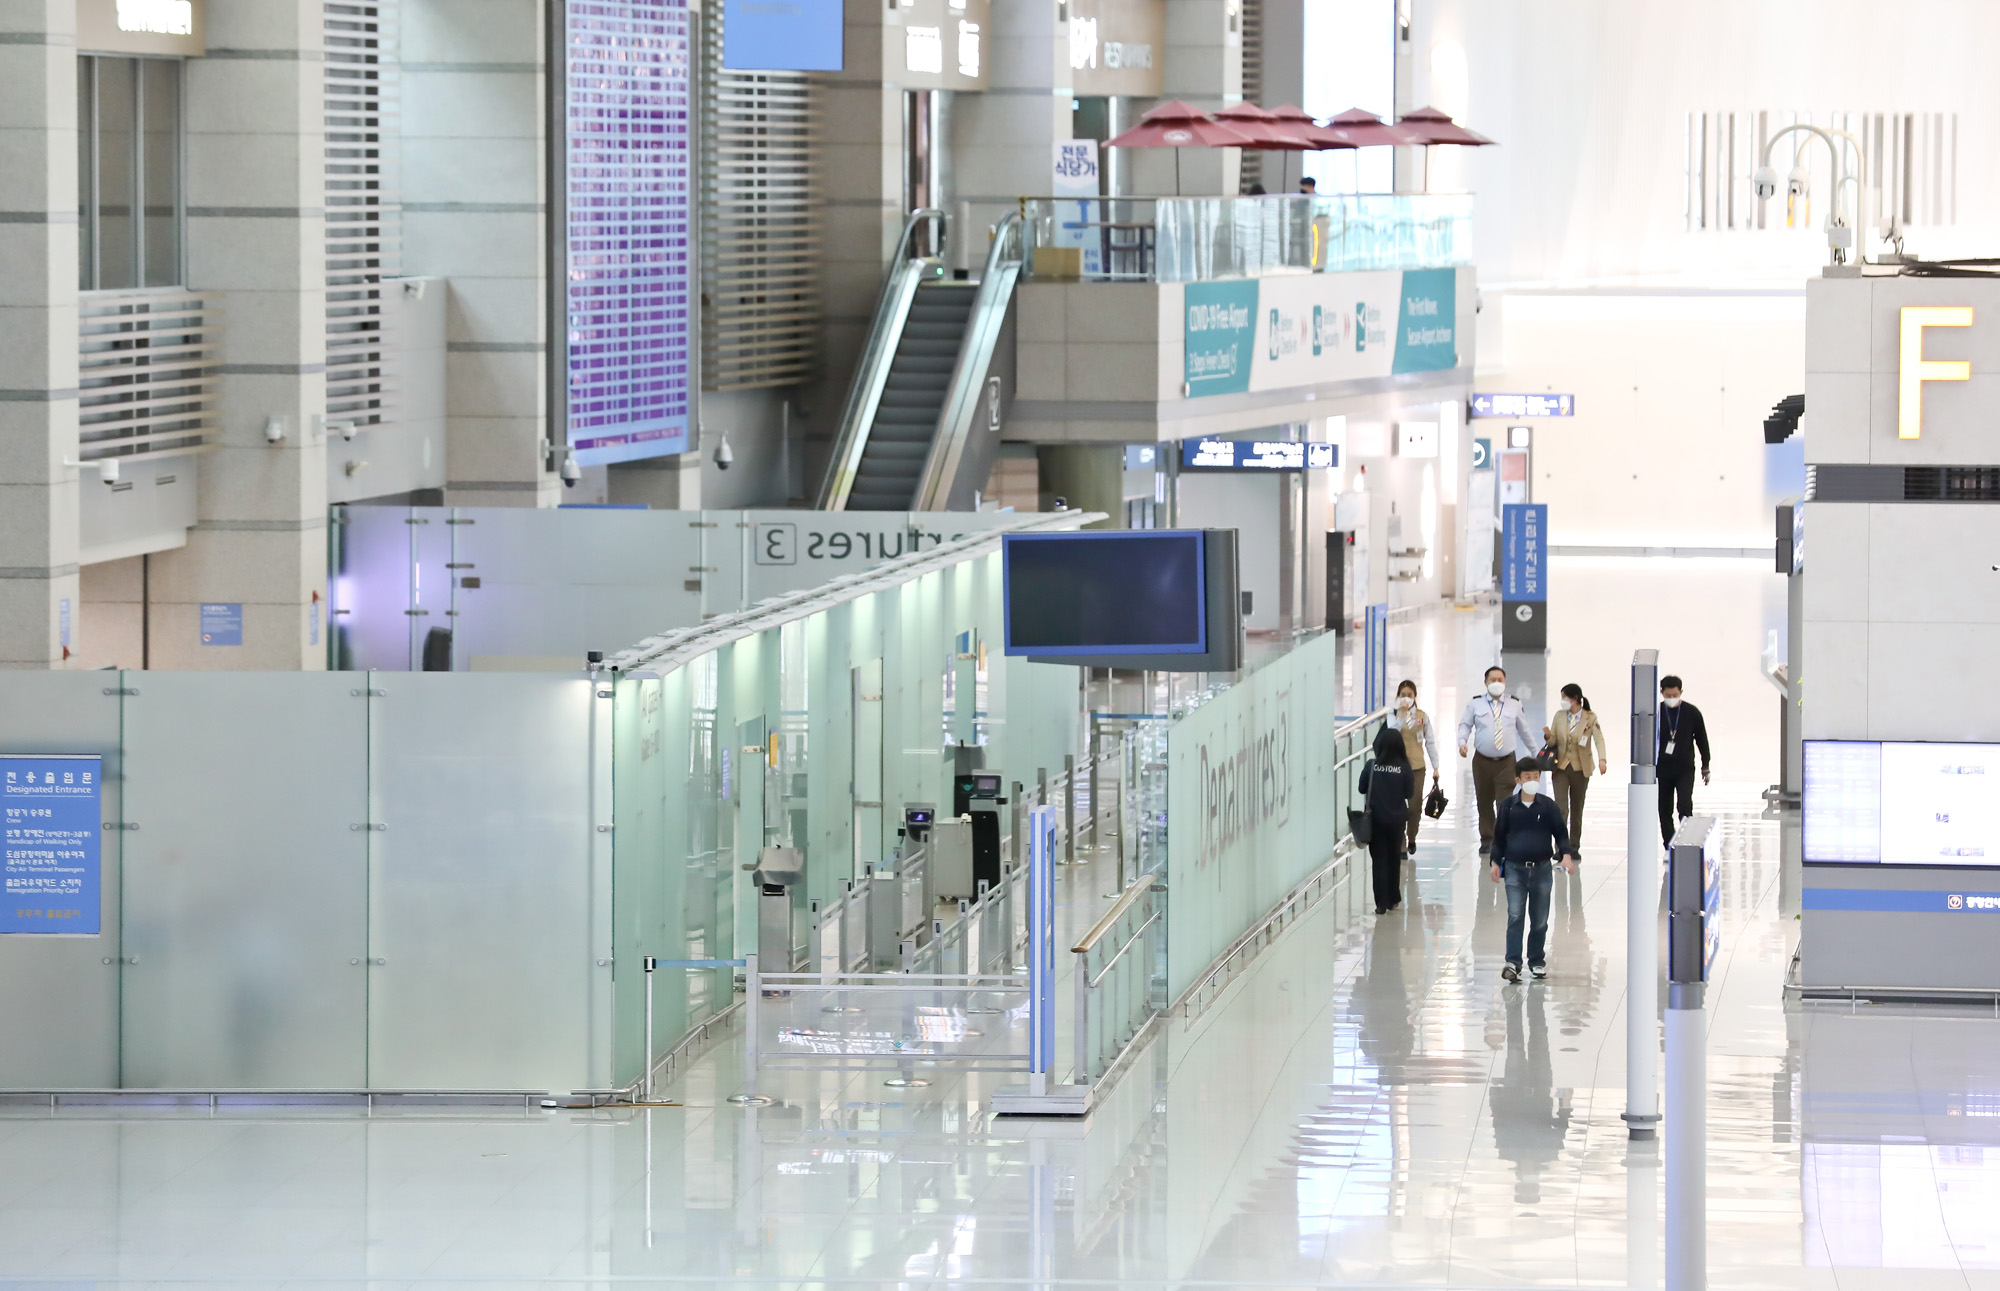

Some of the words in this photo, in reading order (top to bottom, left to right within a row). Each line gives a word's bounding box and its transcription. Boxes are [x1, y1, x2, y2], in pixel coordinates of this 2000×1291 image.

[1061, 145, 1088, 162] 전문
[1056, 161, 1097, 177] 식당가
[1189, 304, 1216, 331] COVID-19
[1229, 302, 1249, 334] Airport
[1899, 306, 1974, 440] F
[1373, 764, 1401, 774] CUSTOMS
[6, 785, 53, 794] Designated
[55, 785, 92, 794] Entrance
[1200, 727, 1276, 891] Departures
[1280, 711, 1287, 808] 3
[6, 808, 28, 817] 항공기
[30, 808, 52, 817] 승무원
[6, 850, 54, 858] 도심공항터미널
[57, 850, 85, 859] 이용여객
[60, 878, 82, 887] 소지자
